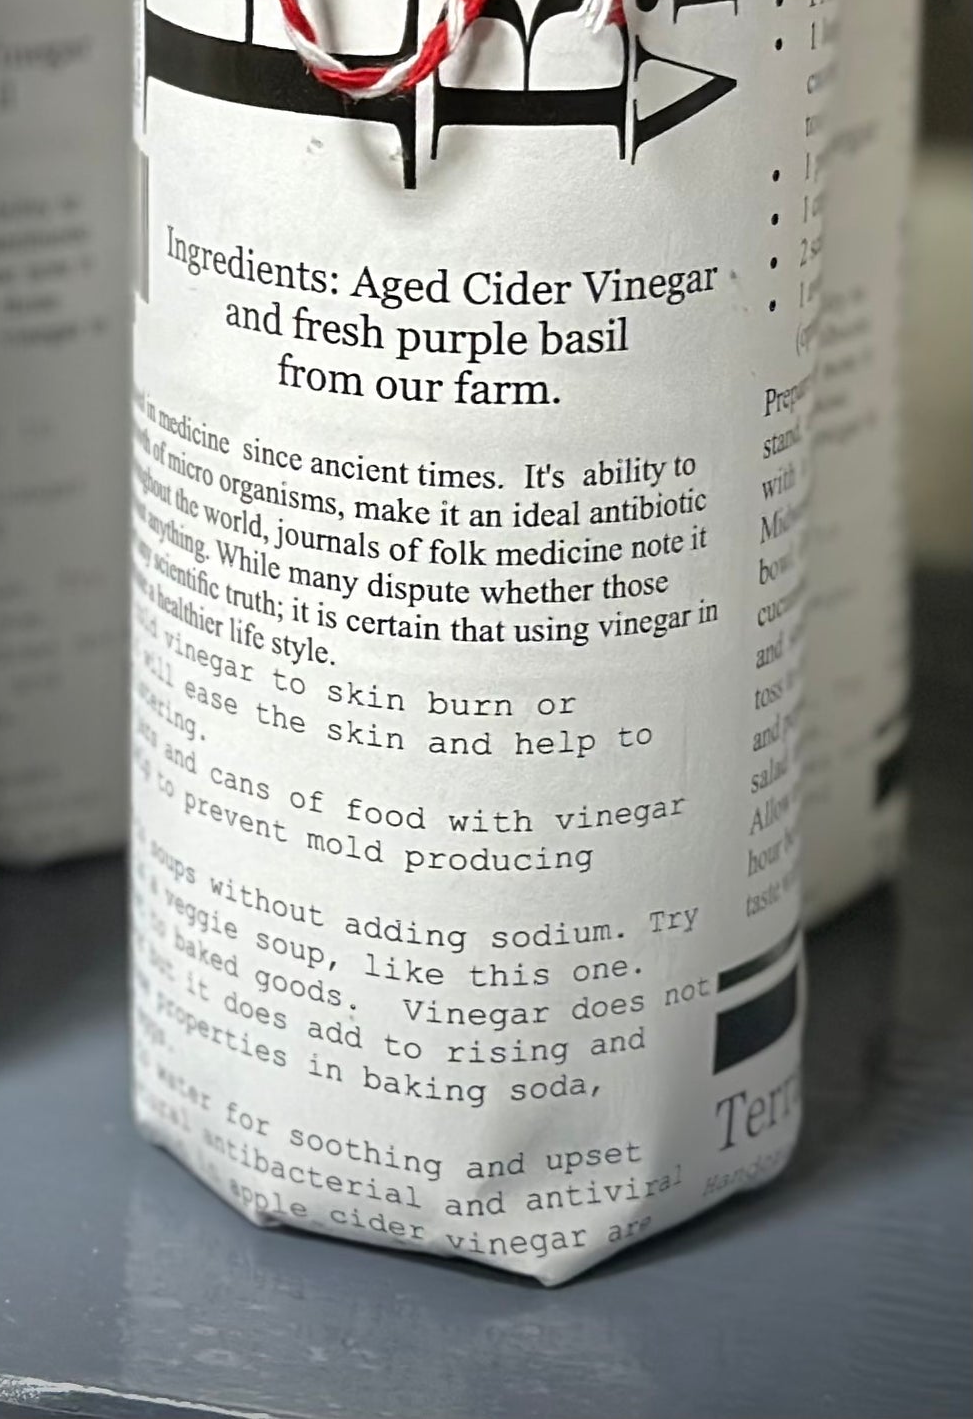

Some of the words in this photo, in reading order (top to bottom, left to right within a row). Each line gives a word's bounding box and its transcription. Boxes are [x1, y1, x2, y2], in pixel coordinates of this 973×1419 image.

[168, 226, 338, 295] Ingredients:
[350, 266, 450, 309] Aged
[463, 270, 572, 307] Cider
[582, 267, 718, 305] Vinegar
[226, 302, 283, 336] and
[292, 306, 384, 349] fresh
[396, 321, 527, 364] purple
[538, 317, 628, 355] basil
[278, 353, 364, 396] from
[376, 376, 443, 402] our
[454, 370, 560, 404] farm.
[159, 410, 229, 456] medicine
[243, 438, 302, 471] since
[311, 455, 408, 484] ancient
[418, 465, 503, 489] times.
[525, 464, 564, 489] It's
[583, 457, 667, 488] ability
[674, 456, 695, 477] to
[220, 475, 344, 520] organisms,
[354, 498, 430, 524] make
[440, 500, 459, 526] it
[469, 502, 502, 528] an
[513, 501, 580, 527] ideal
[590, 488, 706, 524] antibiotic
[204, 506, 269, 544] world,
[274, 527, 379, 558] journals
[389, 537, 423, 562] of
[429, 539, 487, 565] folk
[496, 538, 622, 566] medicine
[631, 533, 683, 559] note
[691, 527, 707, 550] it
[216, 540, 280, 579] While
[289, 567, 359, 599] many
[368, 572, 469, 607] dispute
[480, 578, 594, 604] whether
[602, 574, 668, 599] those
[226, 585, 283, 623] truth;
[293, 597, 308, 623] it
[318, 602, 337, 629] is
[347, 614, 440, 640] certain
[451, 617, 505, 642] that
[514, 616, 589, 646] using
[598, 610, 691, 638] vinegar
[699, 599, 717, 624] in
[230, 617, 264, 649] life
[272, 636, 335, 665] style.
[185, 681, 237, 715] ease
[257, 703, 305, 733] the
[328, 720, 404, 750] skin
[429, 732, 492, 755] and
[515, 730, 595, 758] help
[618, 728, 652, 747] to
[328, 682, 405, 711] skin
[428, 691, 513, 716] burn
[538, 697, 576, 715] or
[211, 768, 269, 800] cans
[290, 791, 323, 813] of
[347, 798, 426, 829] food
[449, 810, 533, 833] with
[555, 798, 685, 830] vinegar
[185, 792, 288, 842] prevent
[307, 833, 384, 862] mold
[405, 847, 593, 873] producing
[210, 878, 324, 927] without
[346, 917, 467, 954] adding
[492, 924, 624, 948] sodium.
[650, 908, 698, 933] Try
[257, 933, 336, 971] soup,
[365, 953, 444, 985] like
[469, 963, 549, 987] this
[573, 960, 641, 982] one.
[224, 992, 286, 1029] does
[308, 1016, 362, 1048] add
[385, 1035, 422, 1059] to
[447, 1039, 569, 1065] rising
[591, 1026, 645, 1055] and
[255, 970, 356, 1010] goods.
[403, 999, 549, 1031] Vinegar
[572, 995, 644, 1020] does
[665, 977, 709, 1006] not
[309, 1053, 342, 1082] in
[363, 1065, 486, 1108] baking
[511, 1074, 599, 1101] soda,
[227, 1102, 269, 1136] for
[290, 1129, 442, 1181] soothing
[467, 1152, 525, 1184] and
[546, 1143, 641, 1175] upset
[331, 1208, 424, 1239] cider
[446, 1229, 586, 1258] vinegar
[446, 1191, 506, 1217] and
